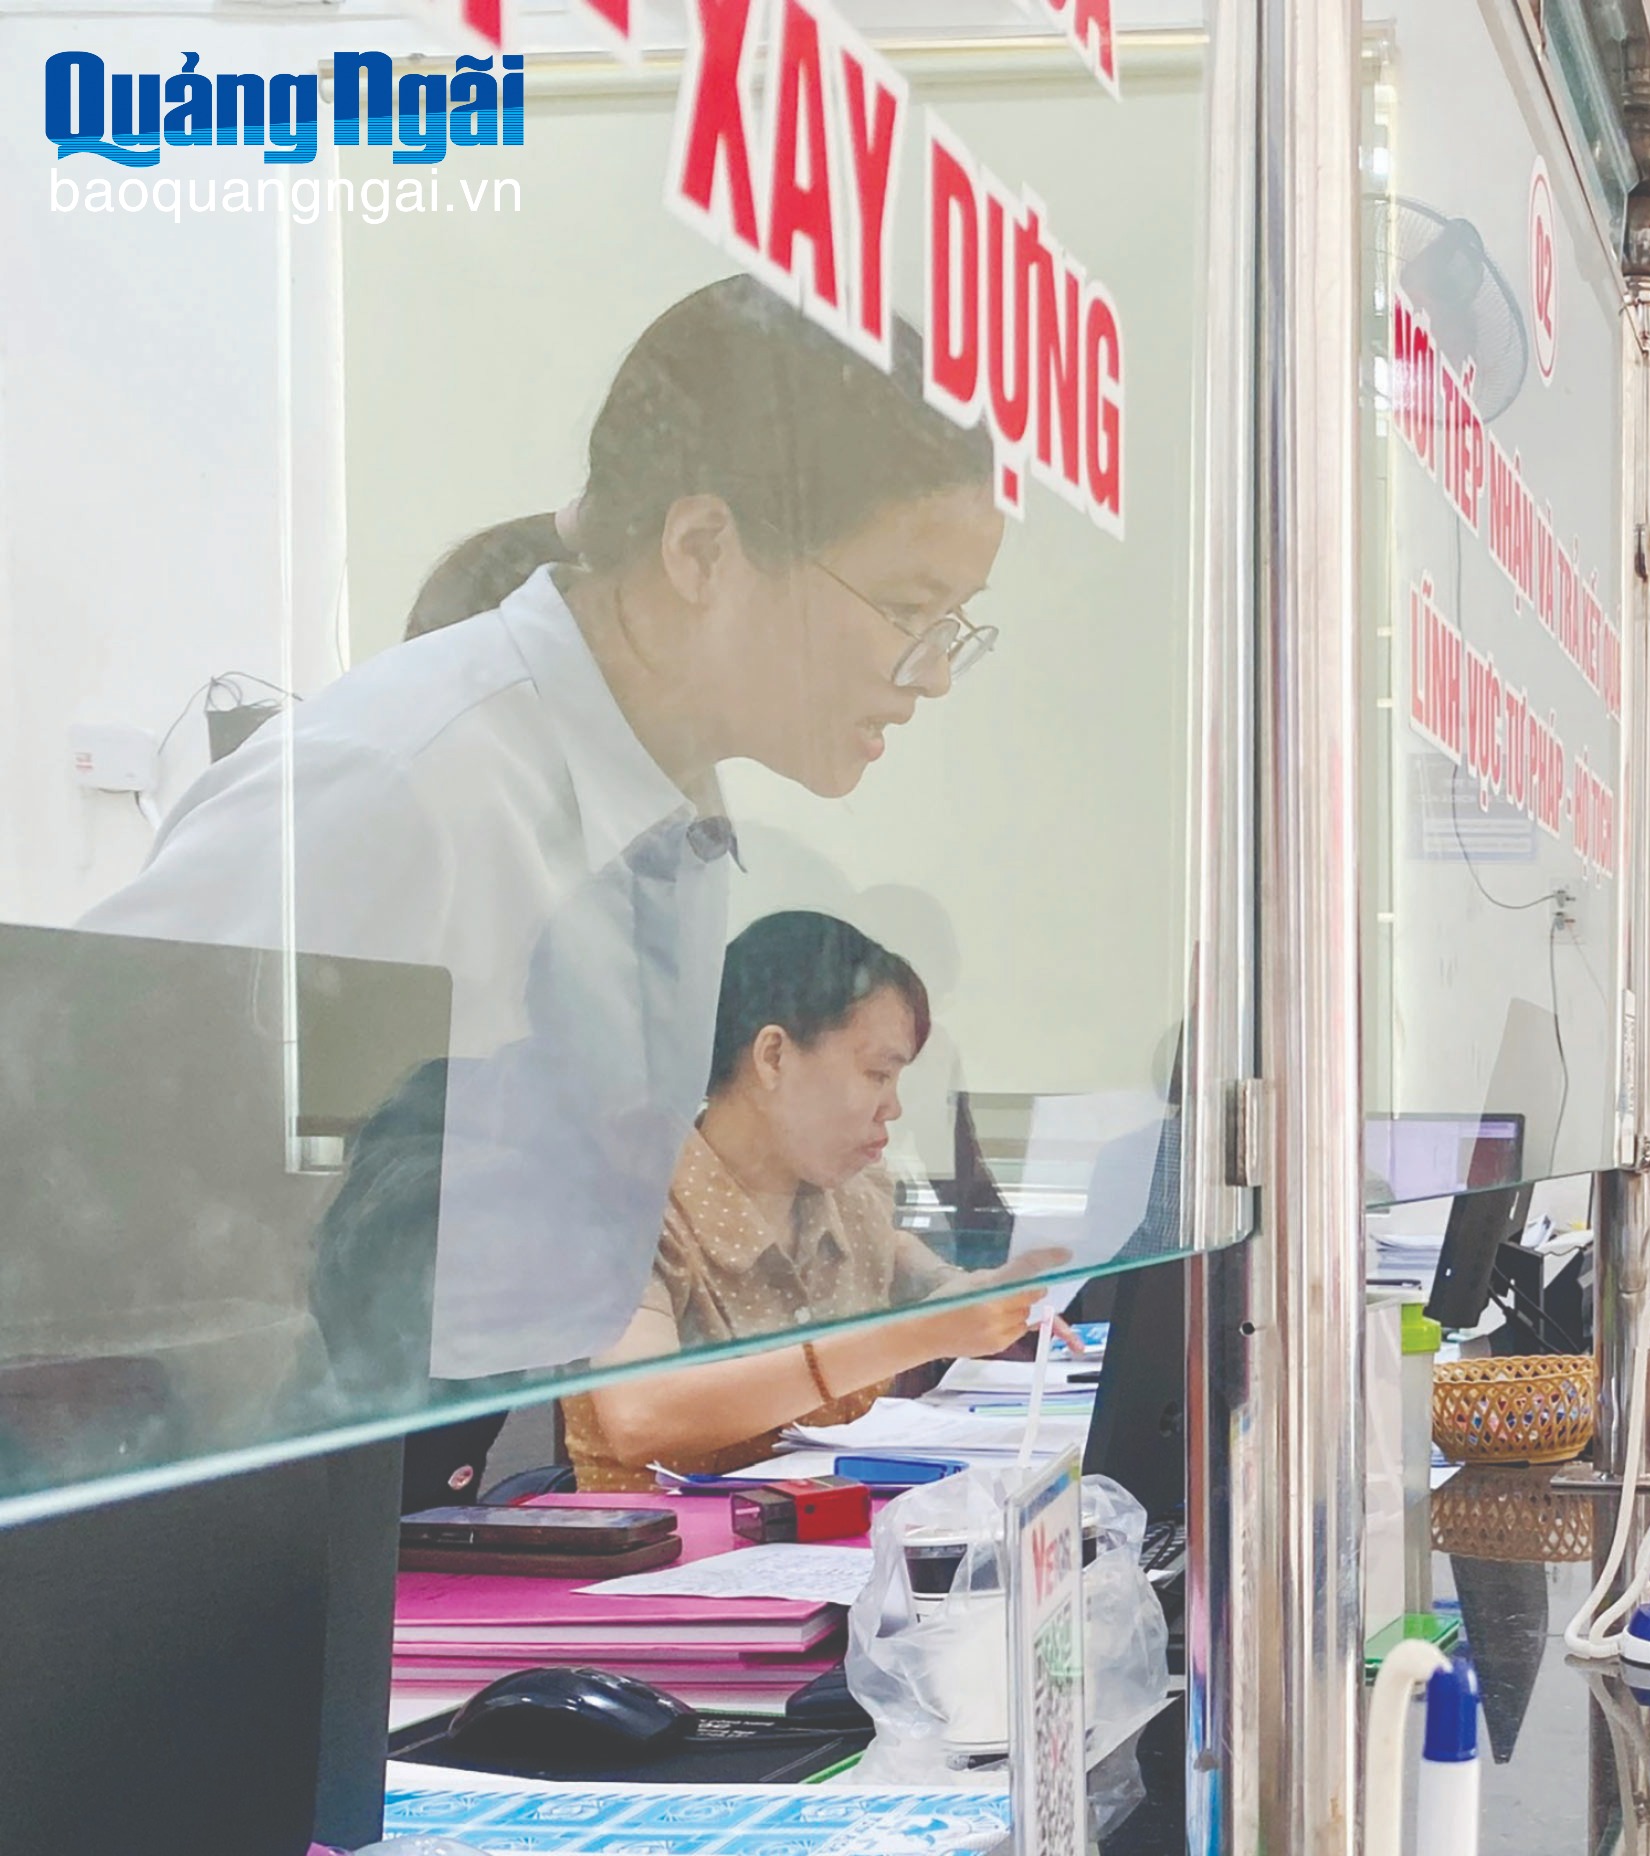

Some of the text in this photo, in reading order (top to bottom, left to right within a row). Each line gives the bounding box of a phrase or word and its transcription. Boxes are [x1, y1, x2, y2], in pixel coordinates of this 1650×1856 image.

[931, 137, 1121, 518] DỰNG
[1536, 215, 1552, 339] 02
[1395, 294, 1435, 472] NƠI
[1442, 364, 1483, 529] TIẾP
[1489, 441, 1533, 612] NHẬN
[1537, 503, 1553, 630] VÀ
[1411, 579, 1462, 756] LĨNH
[1467, 650, 1500, 807] VỰC
[1506, 689, 1526, 803] TƯ
[1528, 711, 1563, 832] PHÁP
[1574, 751, 1589, 877] HỘ
